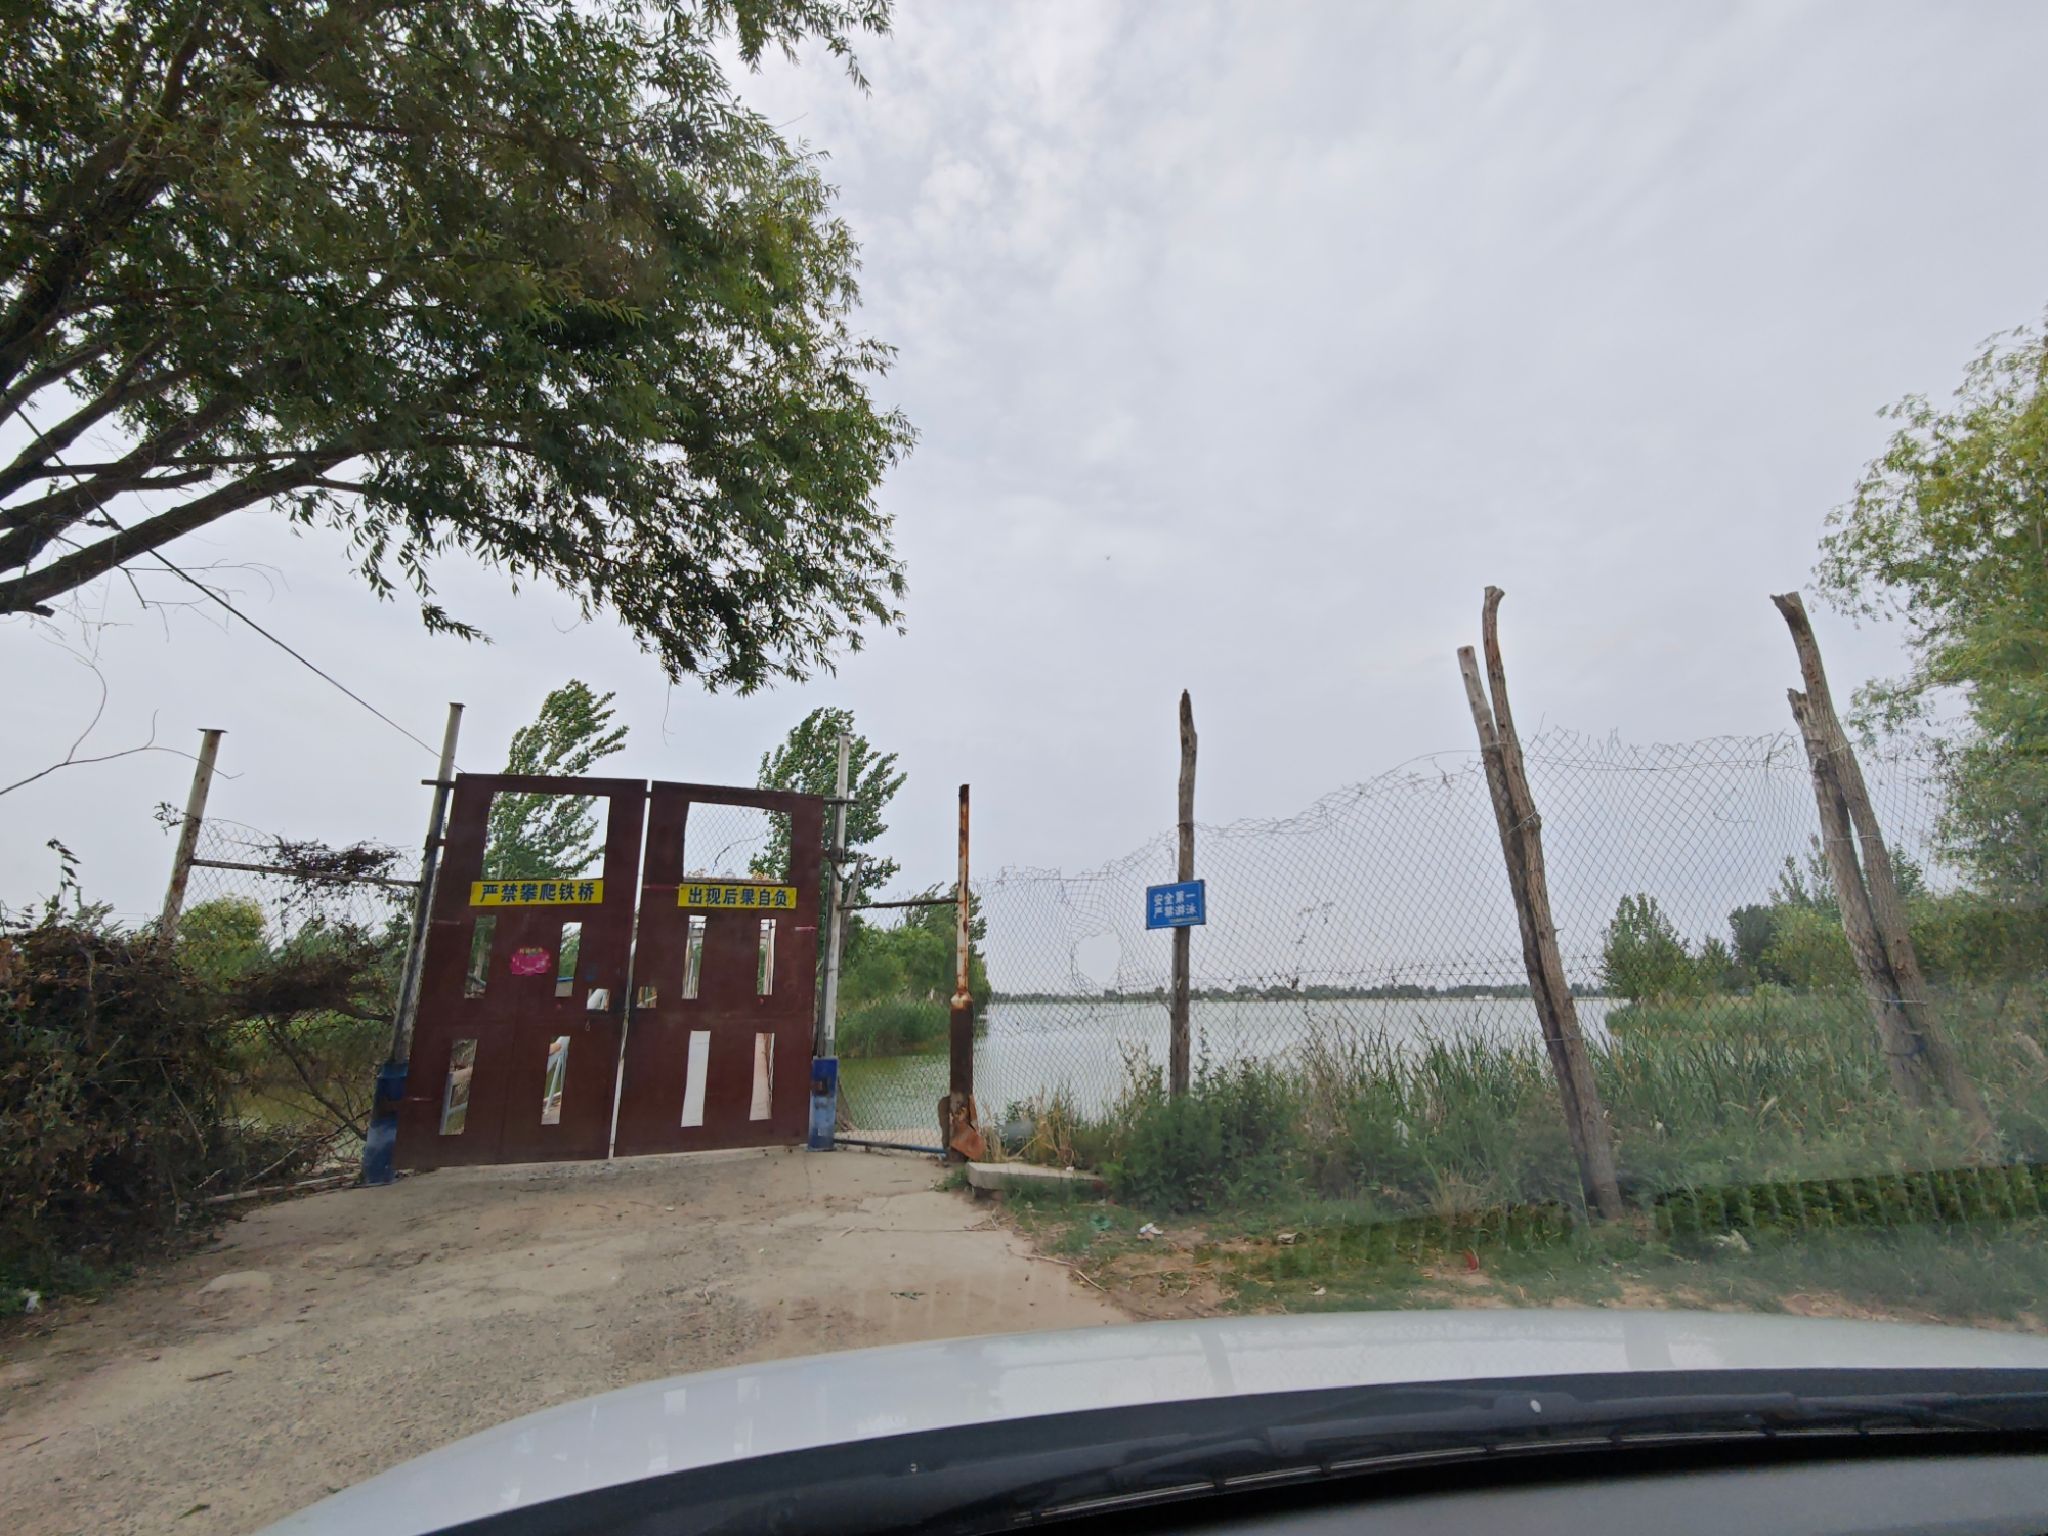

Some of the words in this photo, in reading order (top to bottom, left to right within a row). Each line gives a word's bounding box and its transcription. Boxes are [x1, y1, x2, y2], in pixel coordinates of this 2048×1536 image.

[480, 882, 595, 903] 严禁攀爬铁桥
[688, 886, 787, 907] 出现后果自负
[1153, 890, 1196, 906] 安全第一
